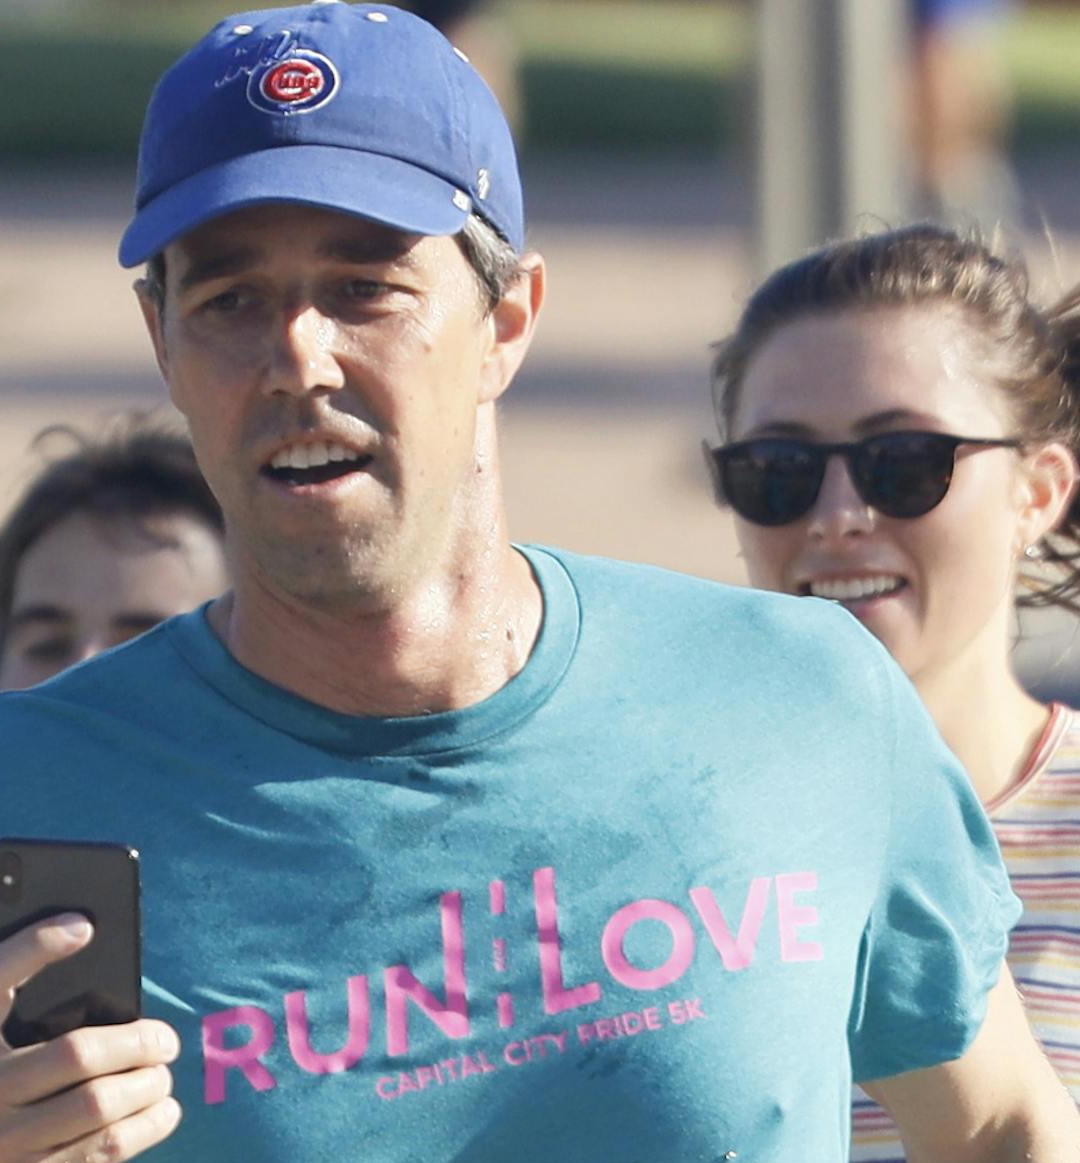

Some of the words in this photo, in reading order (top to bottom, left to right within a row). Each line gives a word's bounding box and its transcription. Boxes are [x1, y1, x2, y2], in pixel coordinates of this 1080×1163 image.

[202, 891, 470, 1104] RUN
[533, 866, 823, 1015] LOVE
[376, 1050, 496, 1100] CAPITAL
[504, 1030, 568, 1066] CITY
[577, 1007, 662, 1045] PRIDE
[668, 998, 706, 1025] 5K
